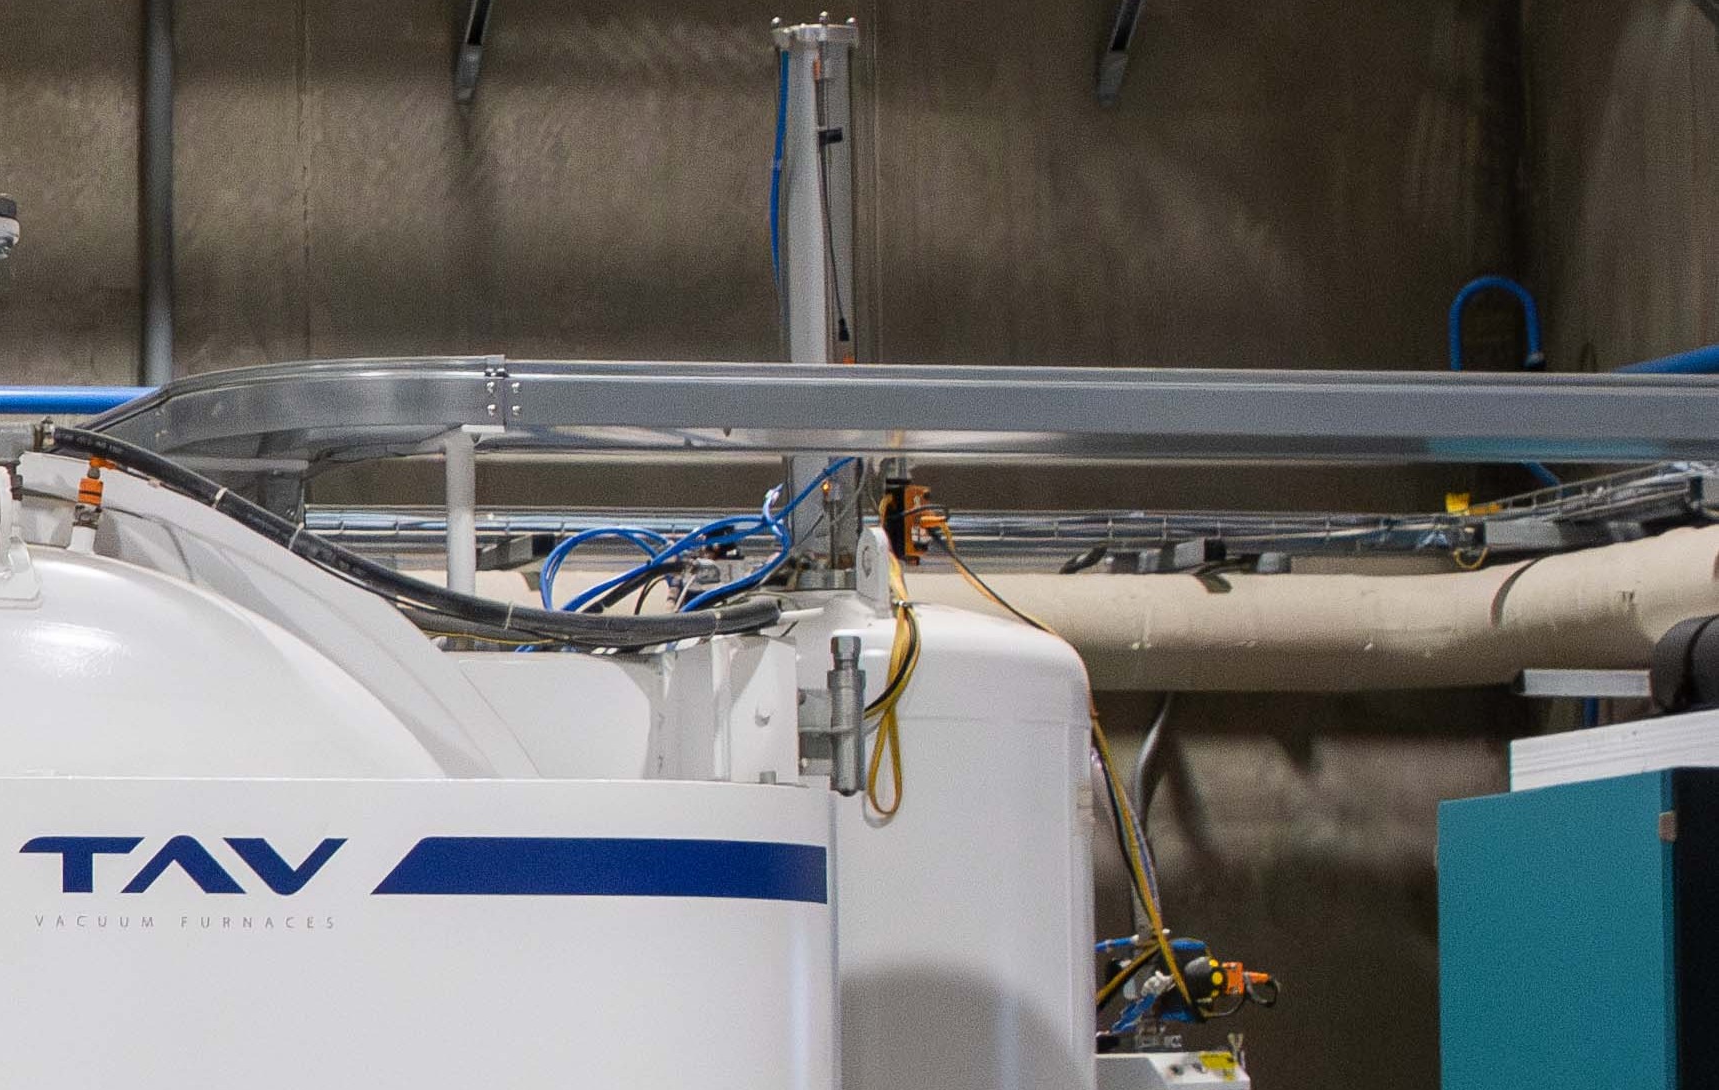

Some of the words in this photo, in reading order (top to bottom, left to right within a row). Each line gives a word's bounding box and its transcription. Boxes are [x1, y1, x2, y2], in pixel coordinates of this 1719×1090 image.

[19, 835, 348, 896] TAV
[34, 914, 154, 928] VACUUM
[180, 915, 334, 929] FURNACES
